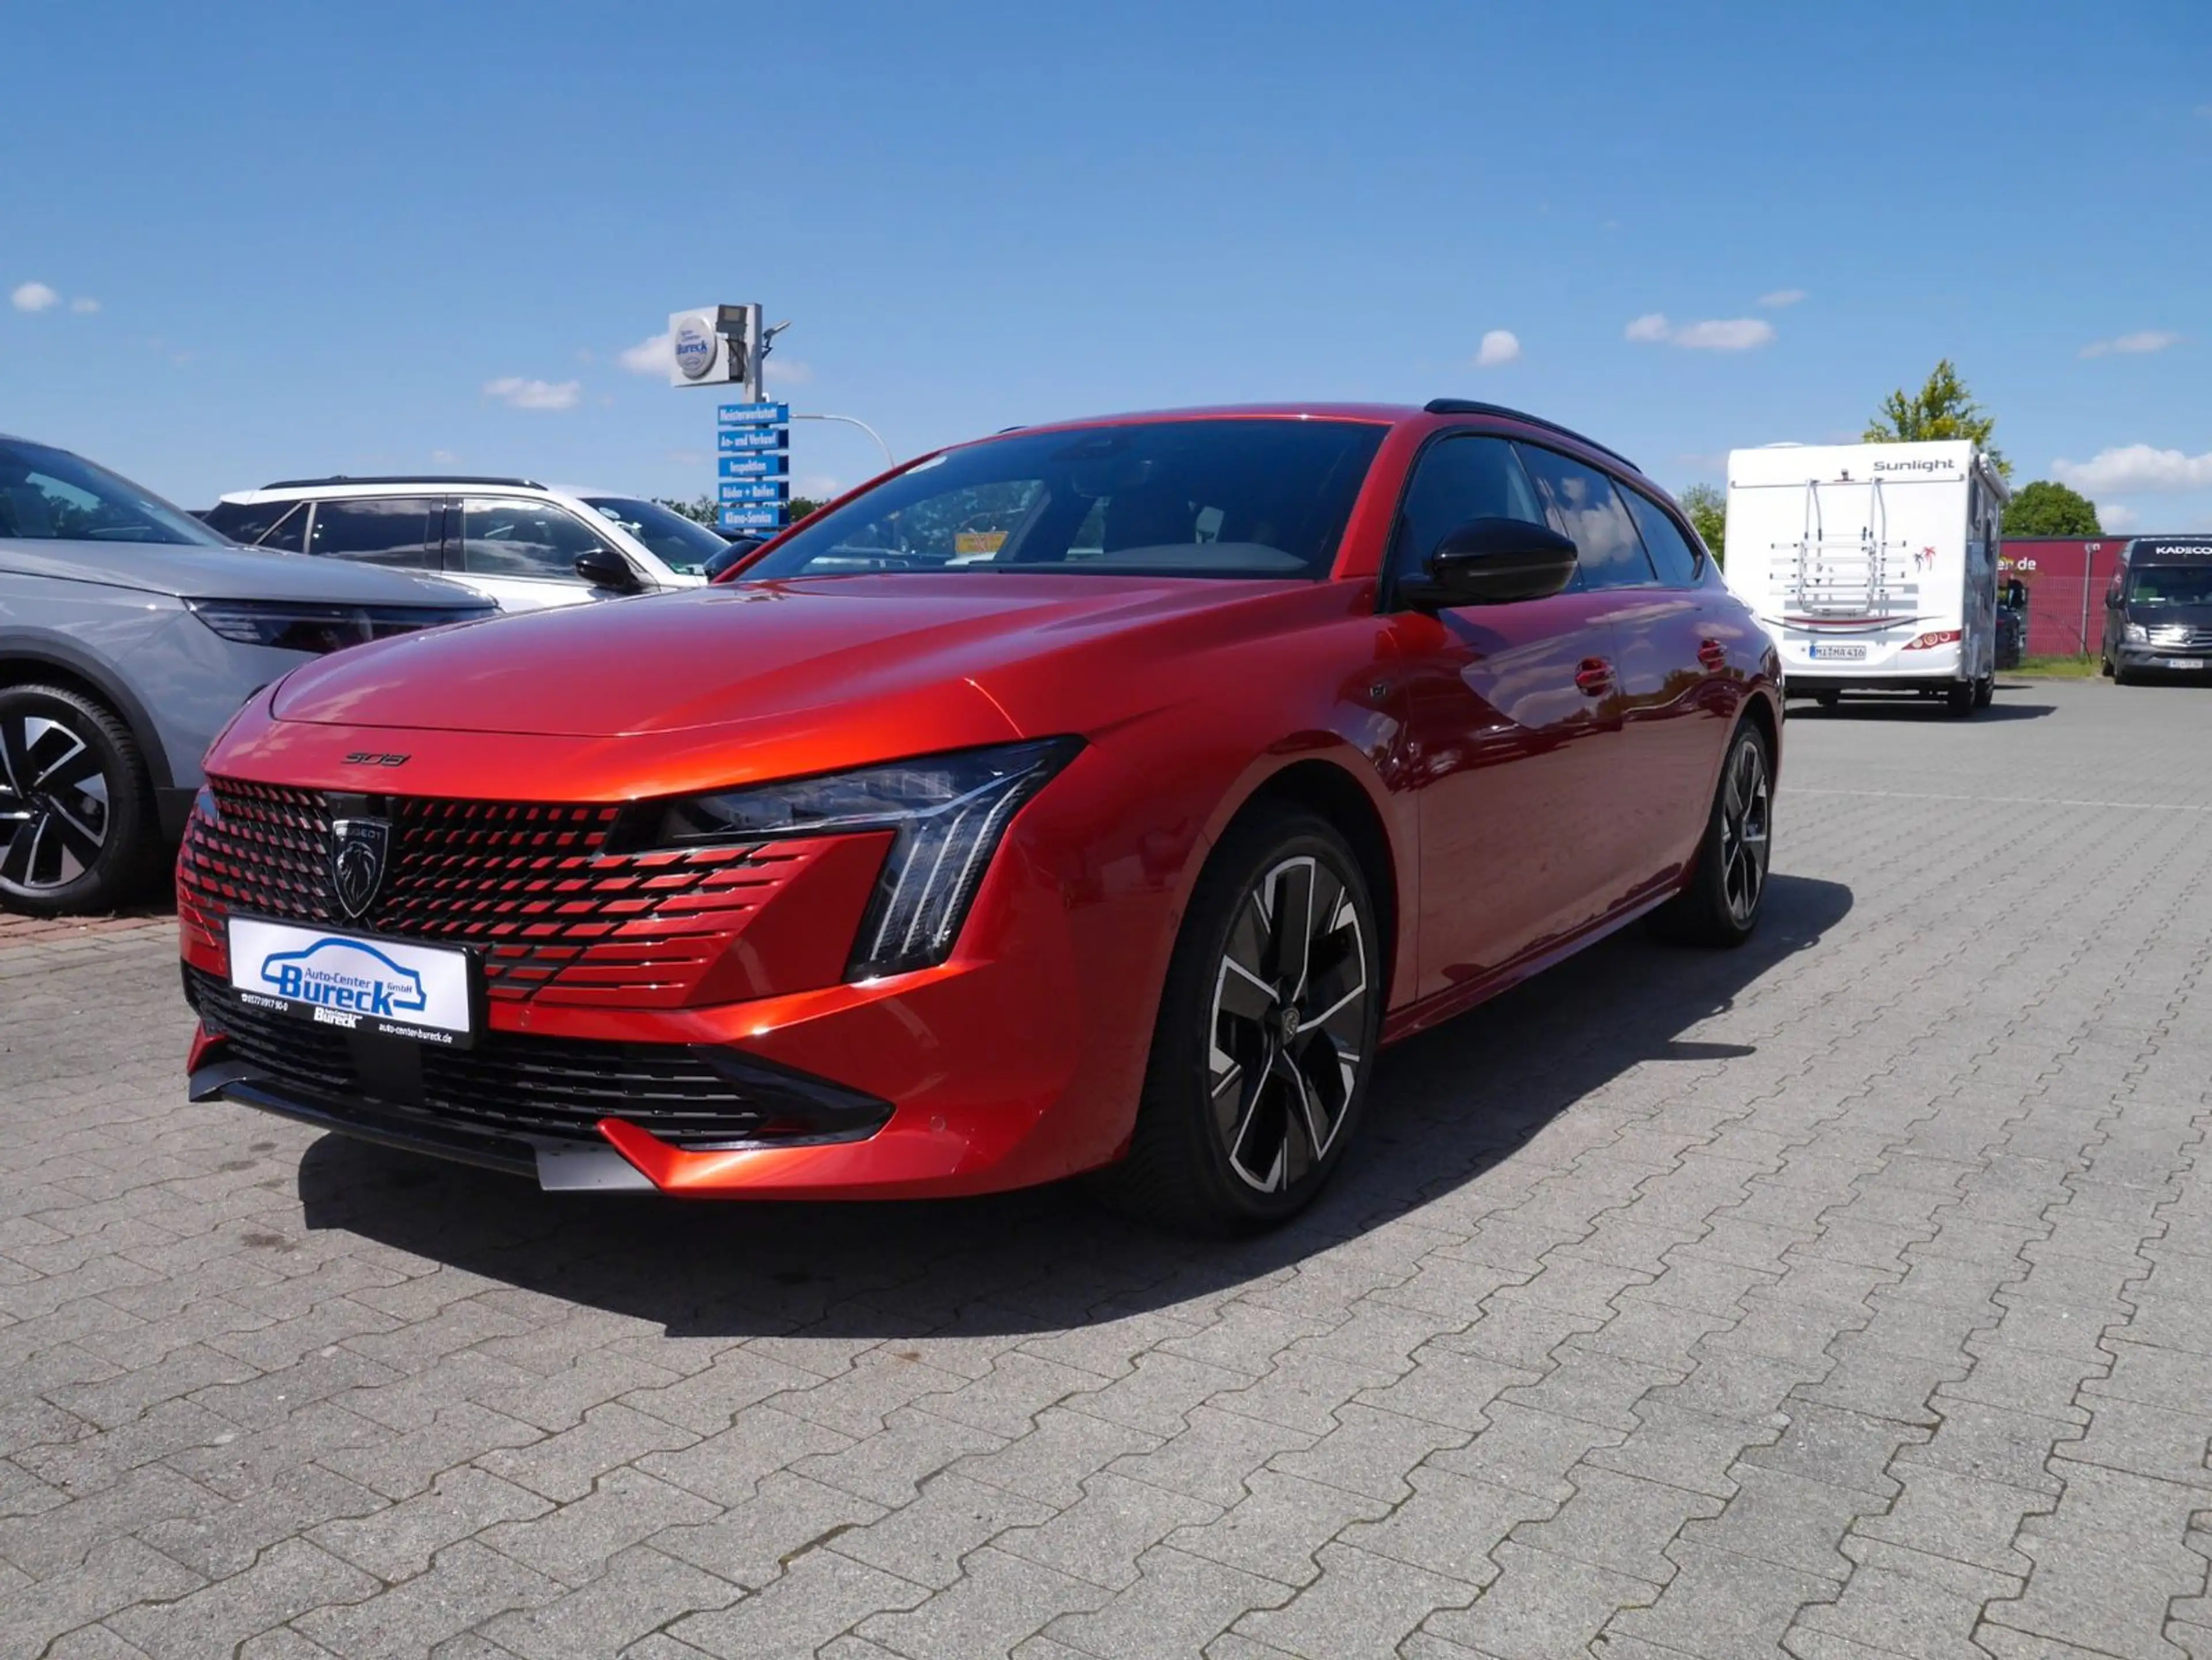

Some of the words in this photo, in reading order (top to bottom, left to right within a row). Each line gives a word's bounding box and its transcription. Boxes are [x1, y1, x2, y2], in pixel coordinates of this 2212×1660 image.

[1873, 459, 1955, 472] Sunlight
[340, 752, 412, 767] 508
[305, 968, 371, 989] Auto-Center
[387, 982, 412, 993] GmbH
[279, 964, 394, 1017] Bureck
[314, 1006, 357, 1028] Bureck
[378, 1023, 453, 1044] auto-center-bureck.de
